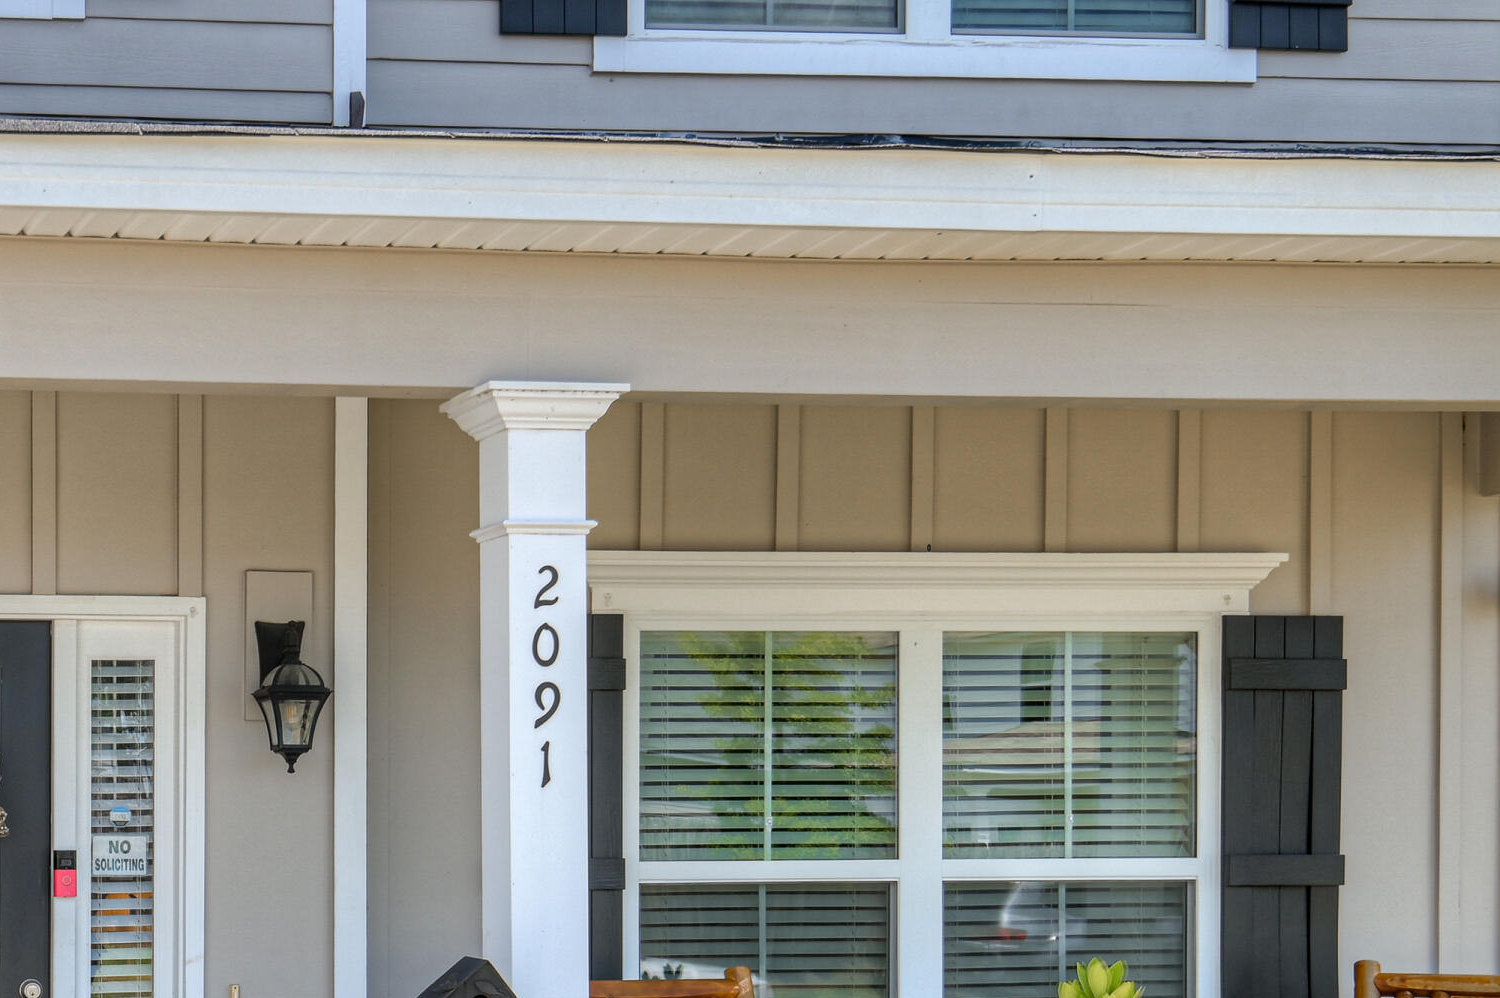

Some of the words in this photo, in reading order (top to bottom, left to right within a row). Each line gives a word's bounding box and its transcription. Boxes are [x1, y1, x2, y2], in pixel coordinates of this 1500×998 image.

[532, 565, 561, 788] 2091
[108, 840, 131, 854] NO
[95, 858, 145, 872] SOLICITING
